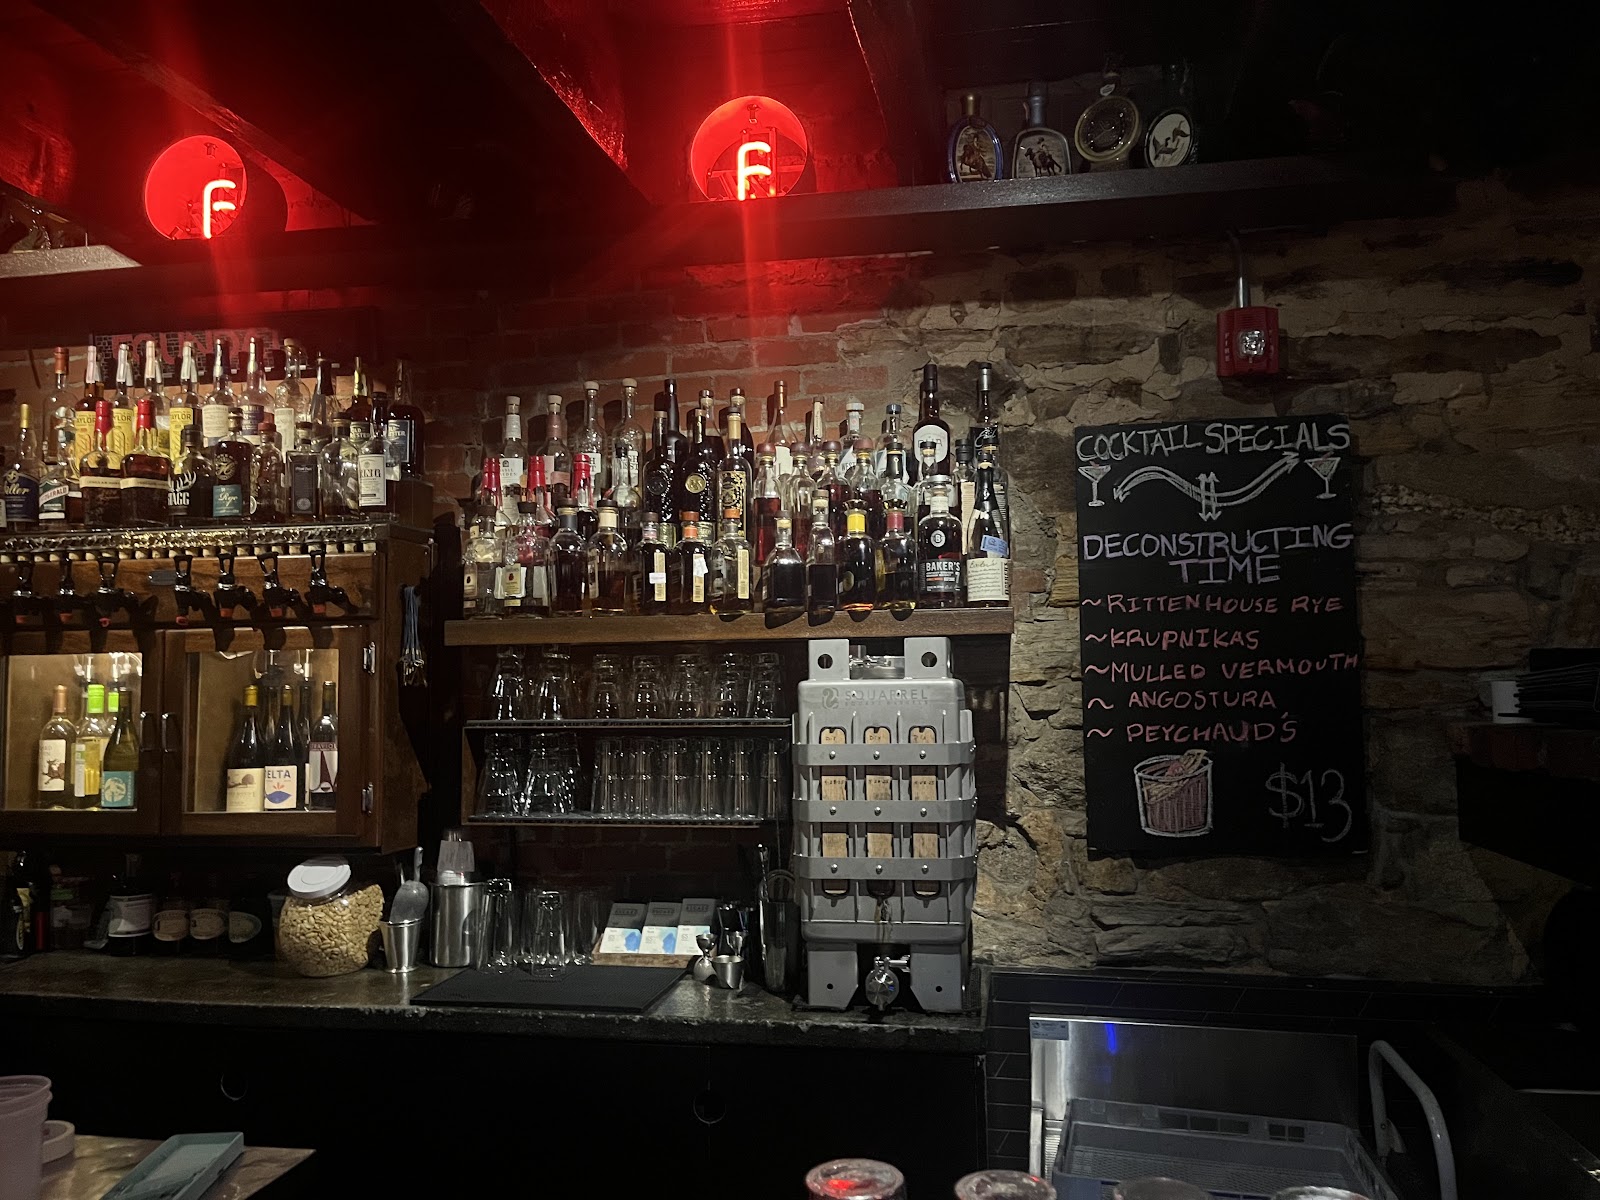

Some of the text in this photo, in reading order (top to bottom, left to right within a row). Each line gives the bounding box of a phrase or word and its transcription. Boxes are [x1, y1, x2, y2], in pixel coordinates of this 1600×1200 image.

[1075, 421, 1351, 461] COCKTAIL SPECIALS
[1083, 523, 1354, 560] DECONSTRUCTING
[926, 561, 960, 572] BAKER'S
[1168, 554, 1281, 584] TIME
[1107, 593, 1344, 614] RITTENHOUSE RYE
[1110, 627, 1261, 650] KRUPNIKAS
[1110, 652, 1359, 683] MULLED VERMOUTH
[1127, 689, 1277, 710] ANGOSTURA
[1126, 711, 1298, 743] PEYCHAUD'S
[1264, 761, 1353, 843] $13
